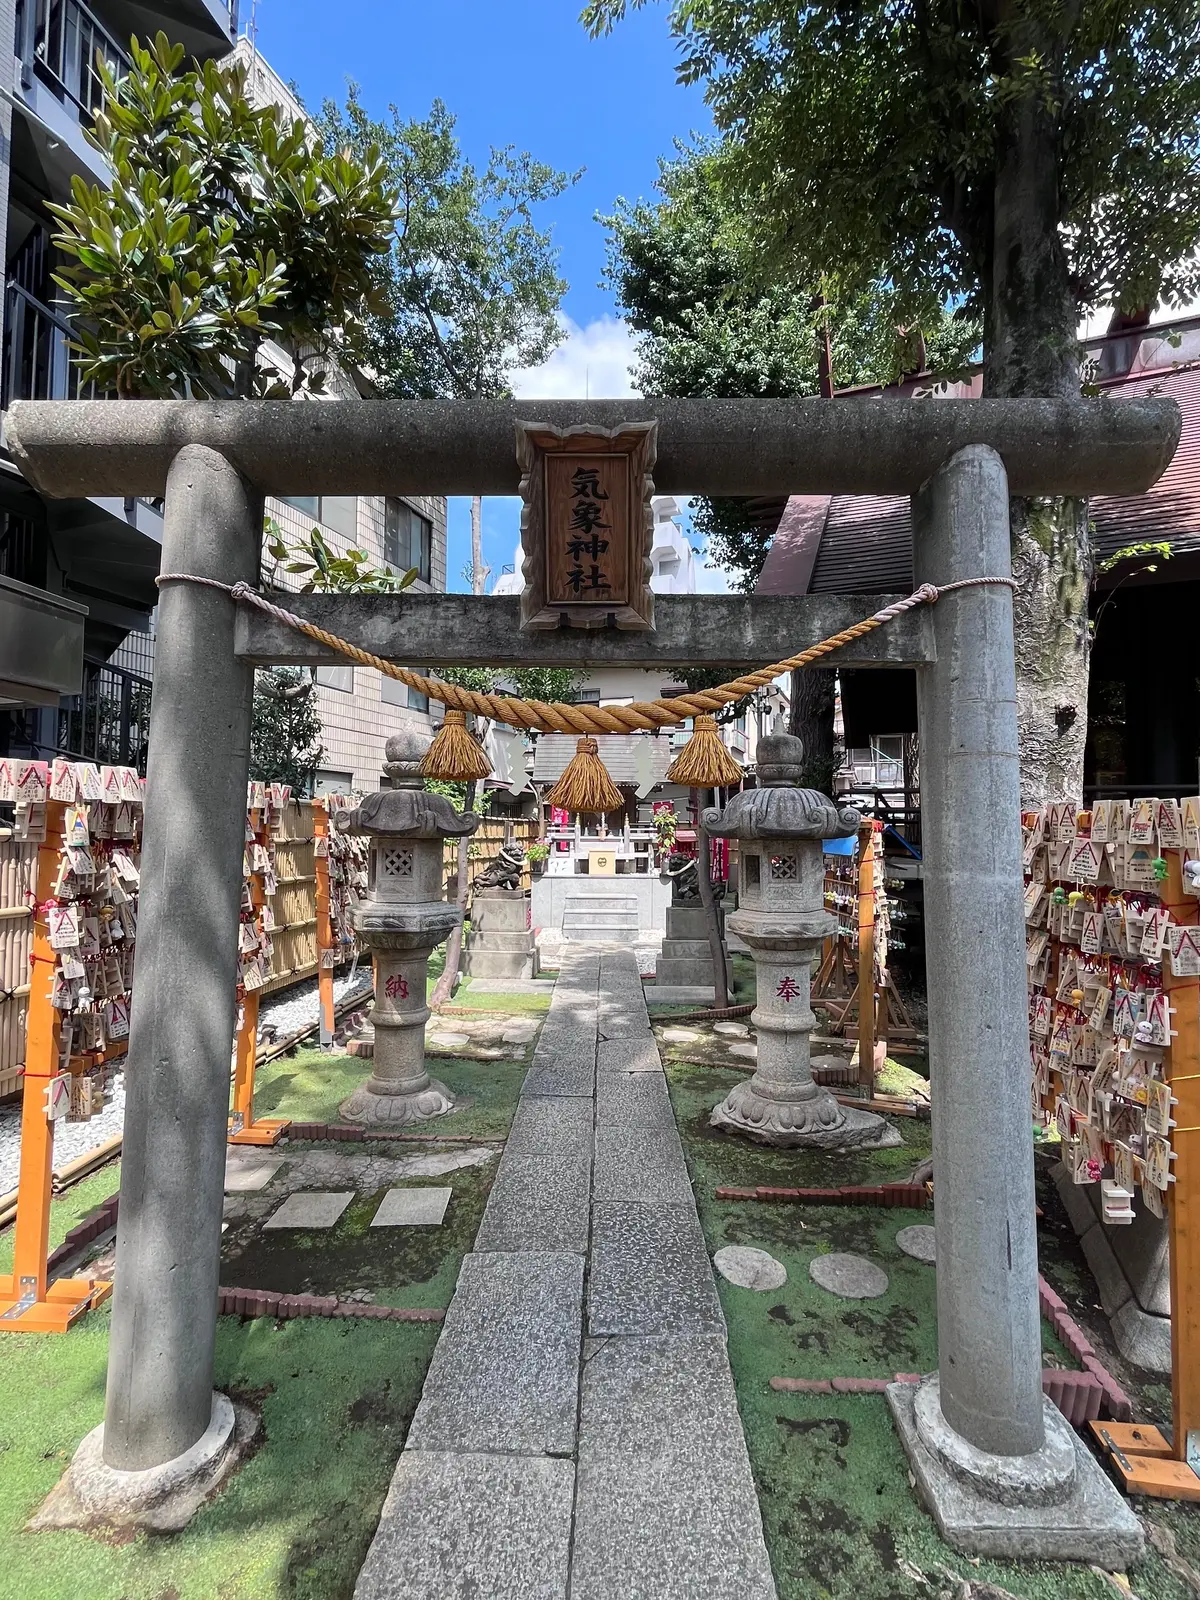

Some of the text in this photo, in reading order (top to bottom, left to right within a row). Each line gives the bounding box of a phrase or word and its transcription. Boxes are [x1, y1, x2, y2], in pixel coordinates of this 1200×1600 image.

[564, 466, 612, 594] 気象神社
[385, 974, 409, 999] 納
[776, 976, 800, 1002] 奉
